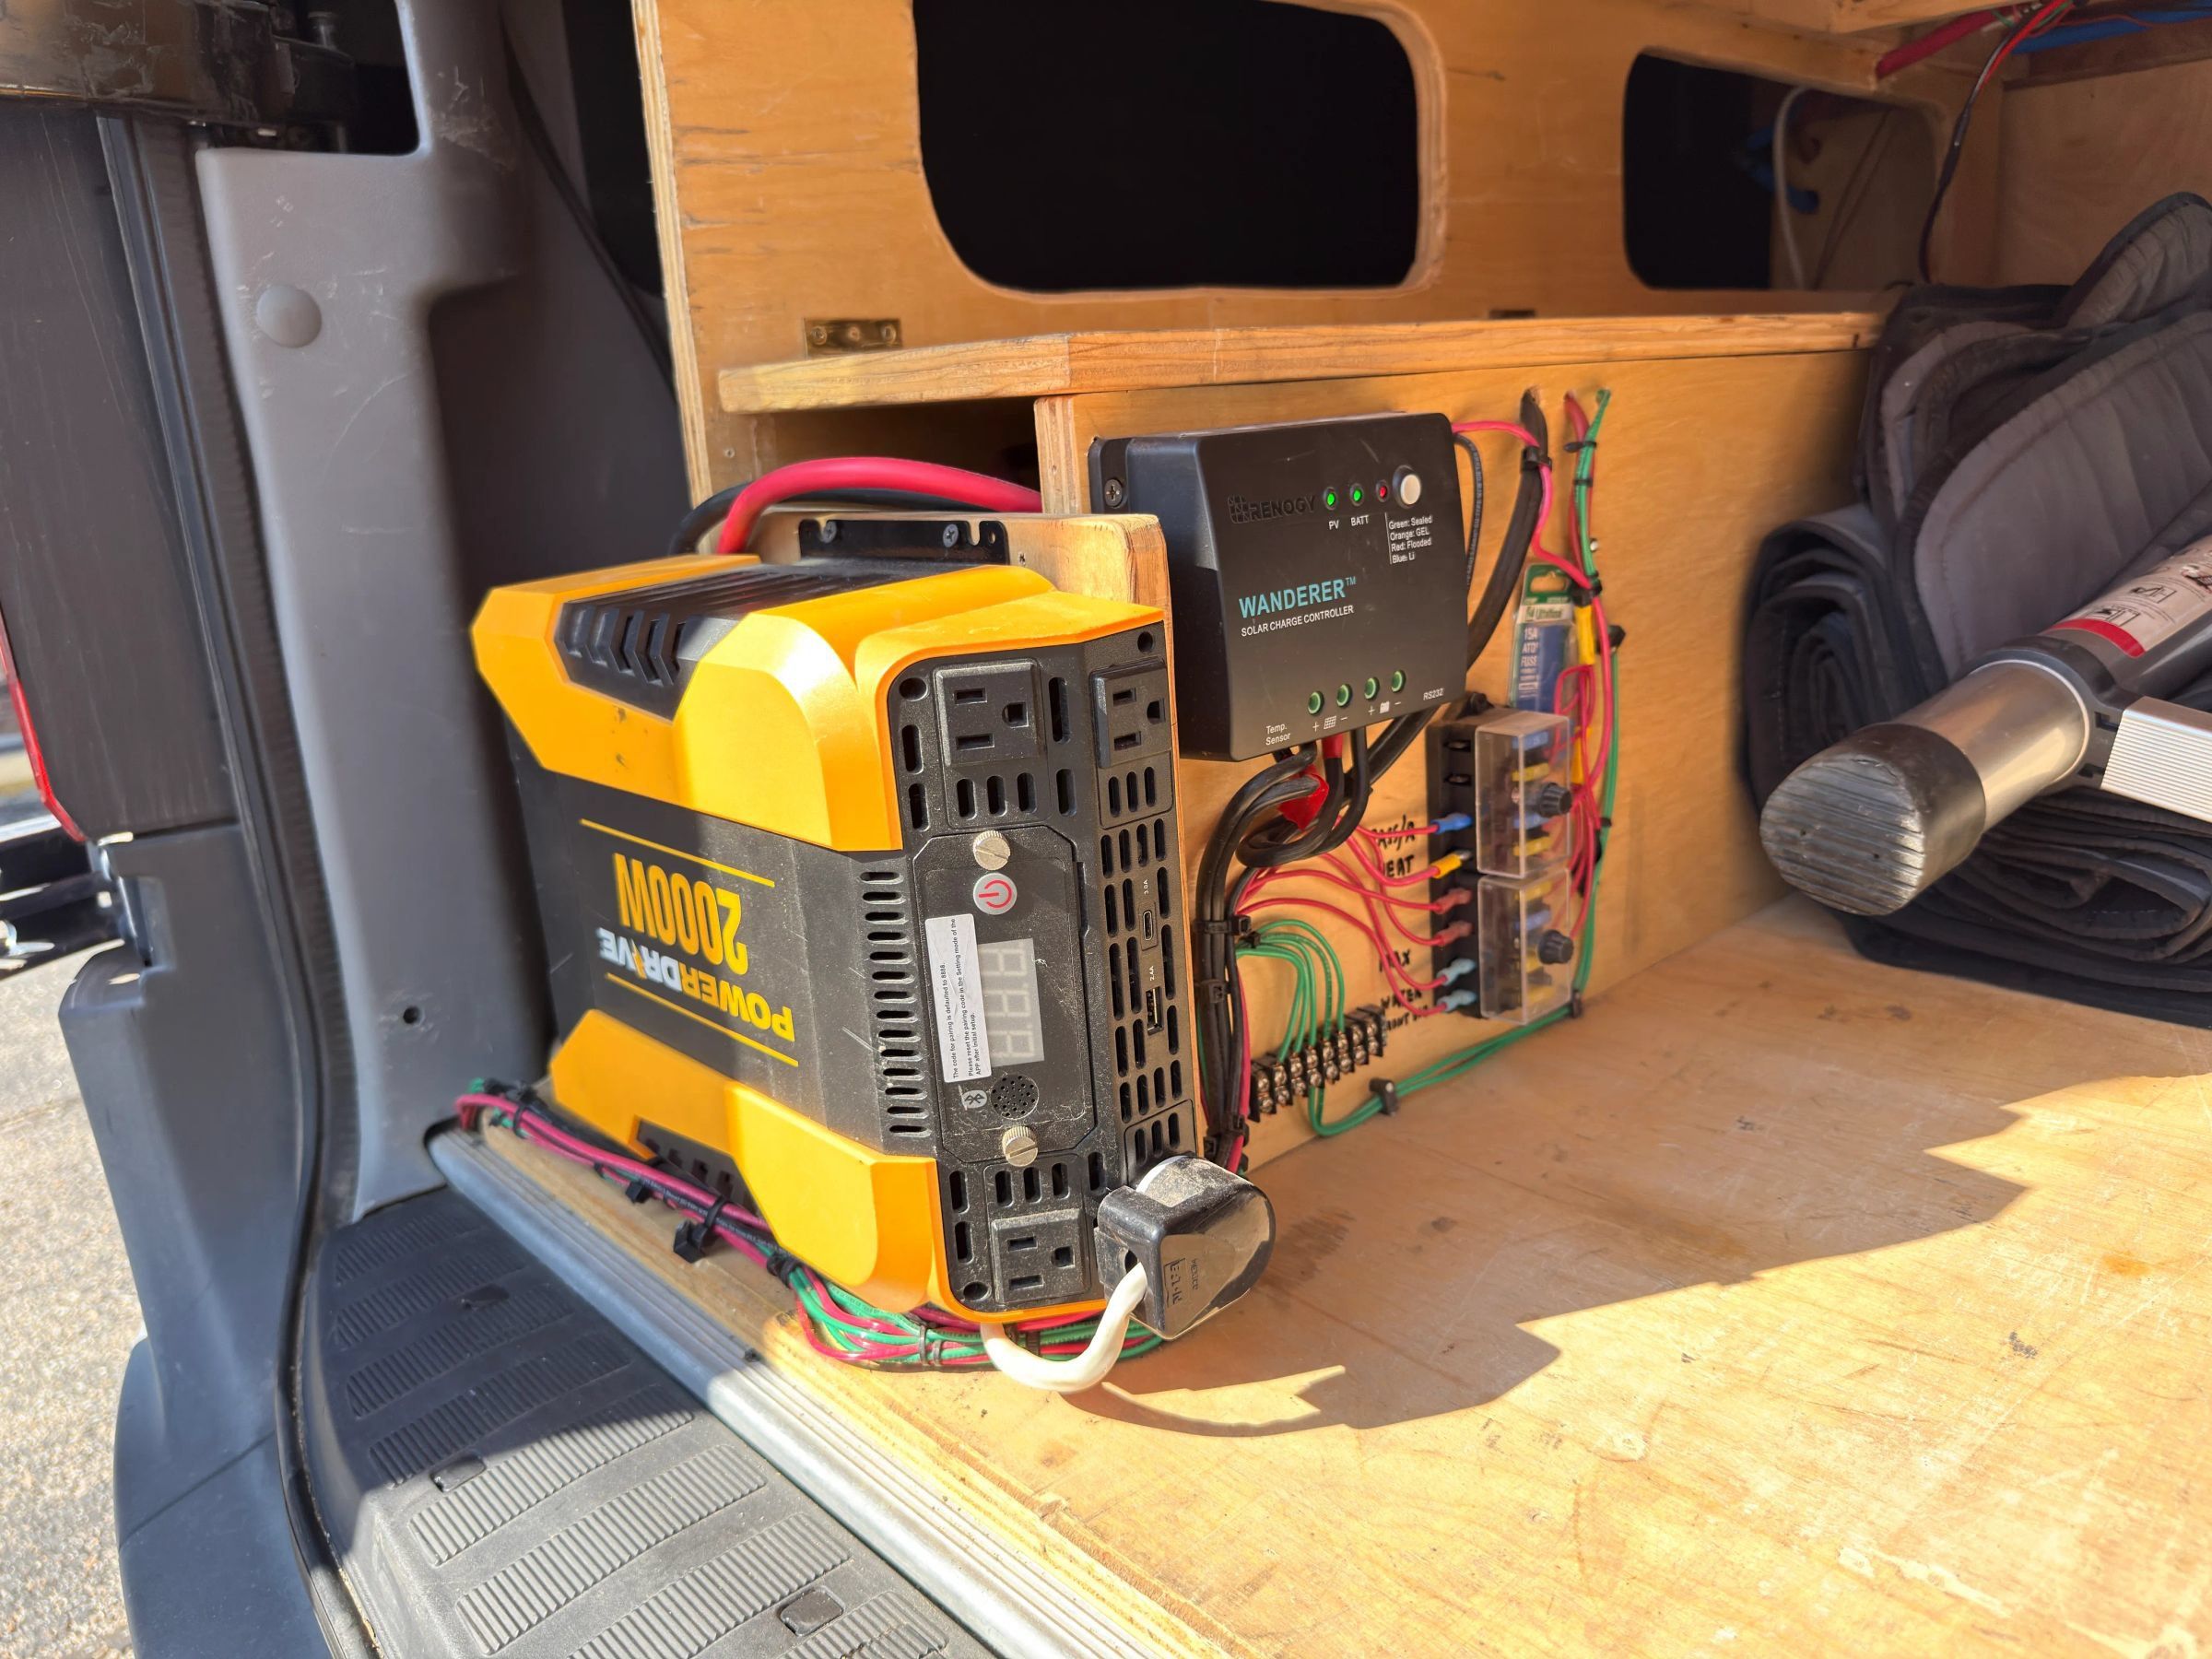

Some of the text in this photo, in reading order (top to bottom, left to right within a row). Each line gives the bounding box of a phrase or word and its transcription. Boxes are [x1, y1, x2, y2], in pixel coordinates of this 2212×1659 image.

[1249, 495, 1315, 522] RENOGY
[1328, 519, 1340, 531] PV
[1350, 514, 1371, 528] BATT
[1388, 514, 1433, 530] Green: Sealed
[1389, 526, 1430, 541] Orange: GEL
[1391, 536, 1433, 552] Red: Flooded
[1408, 551, 1416, 560] Li
[1241, 604, 1355, 638] SOLAR CHARGE CONTROLLER
[1423, 688, 1444, 701] RS232
[1265, 722, 1288, 735] Temp.
[1265, 732, 1291, 747] Sensor
[1382, 853, 1416, 877] EAT
[613, 852, 749, 977] 2000W
[955, 954, 963, 976] Setting
[943, 986, 951, 1014] defaulted
[947, 1021, 956, 1041] pairing
